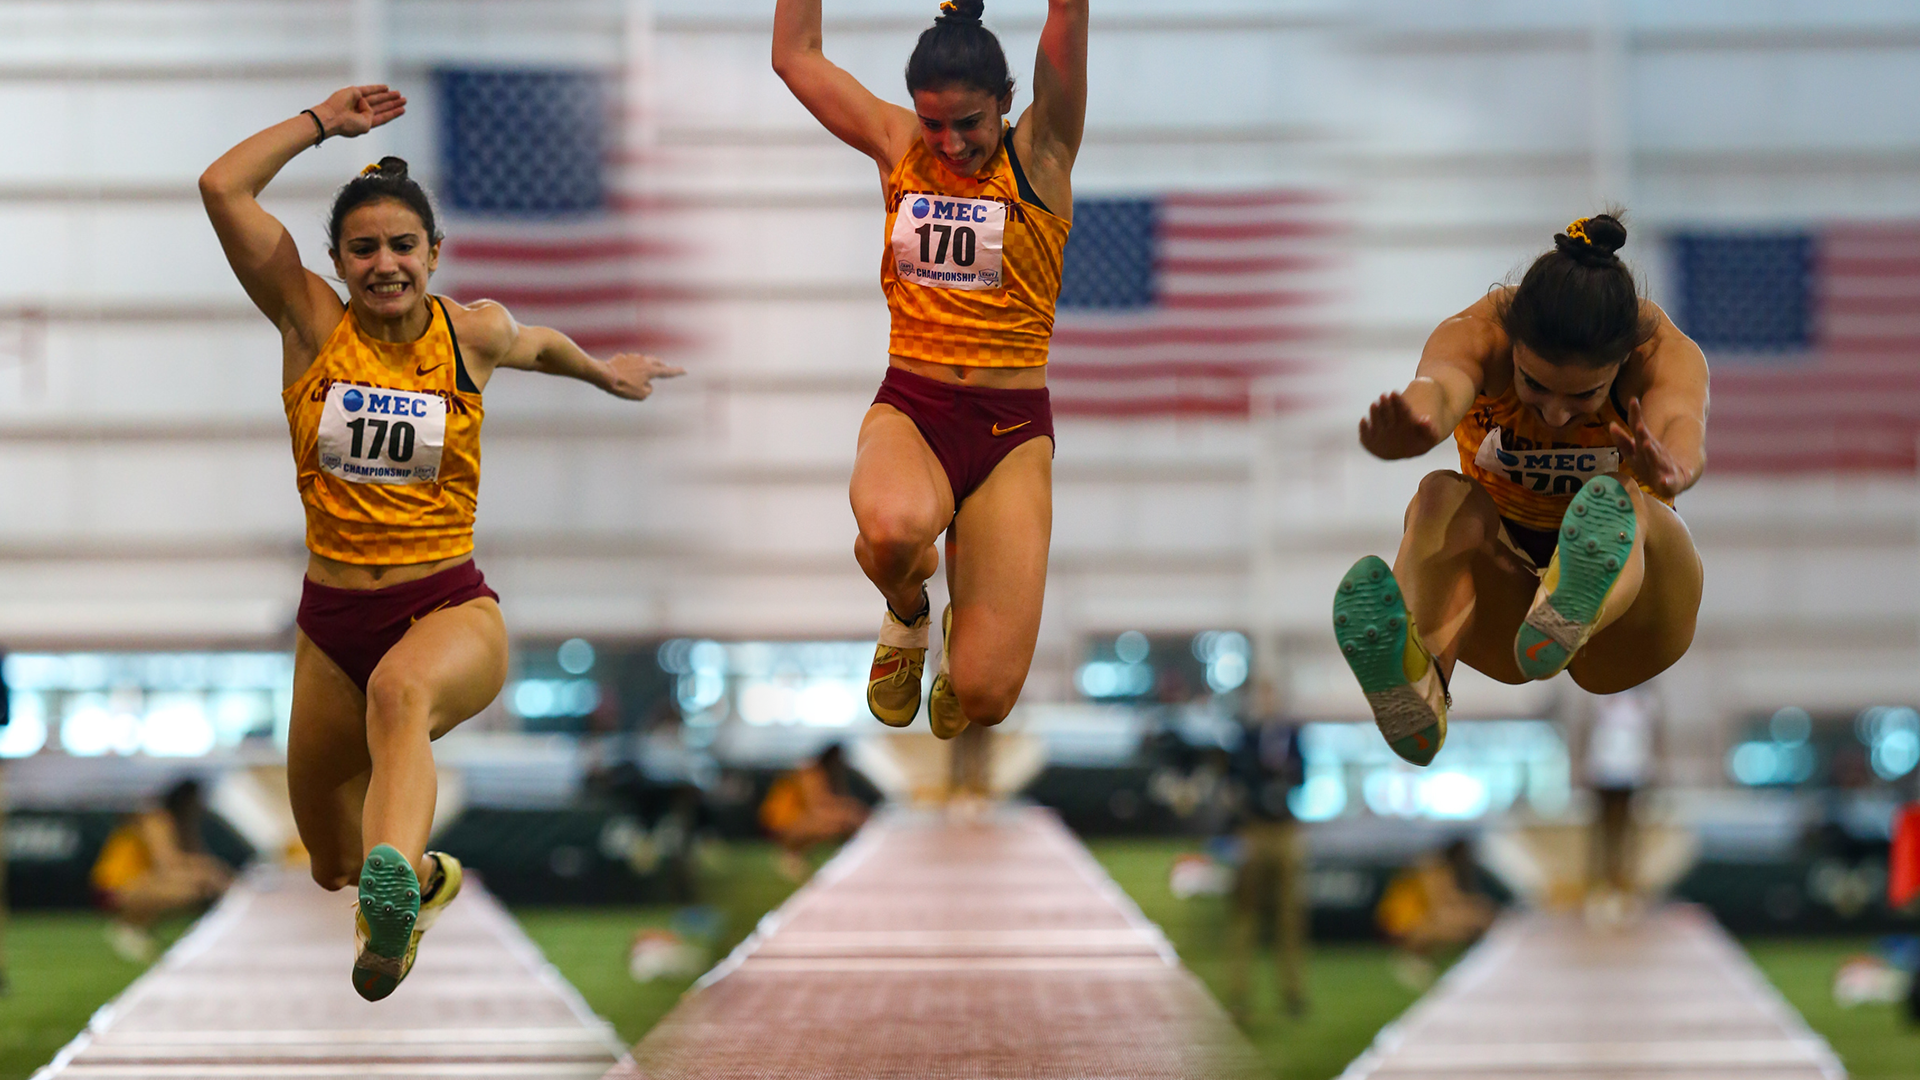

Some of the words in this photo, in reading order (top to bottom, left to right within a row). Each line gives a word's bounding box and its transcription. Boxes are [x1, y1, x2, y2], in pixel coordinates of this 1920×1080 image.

[932, 200, 987, 223] MEC
[914, 223, 976, 267] 170
[916, 268, 976, 282] CHAMPIONSHIP
[367, 393, 427, 418] MEC
[347, 417, 415, 463] 170
[343, 463, 412, 478] CHAMPIONSHIP
[1524, 454, 1596, 472] MEC
